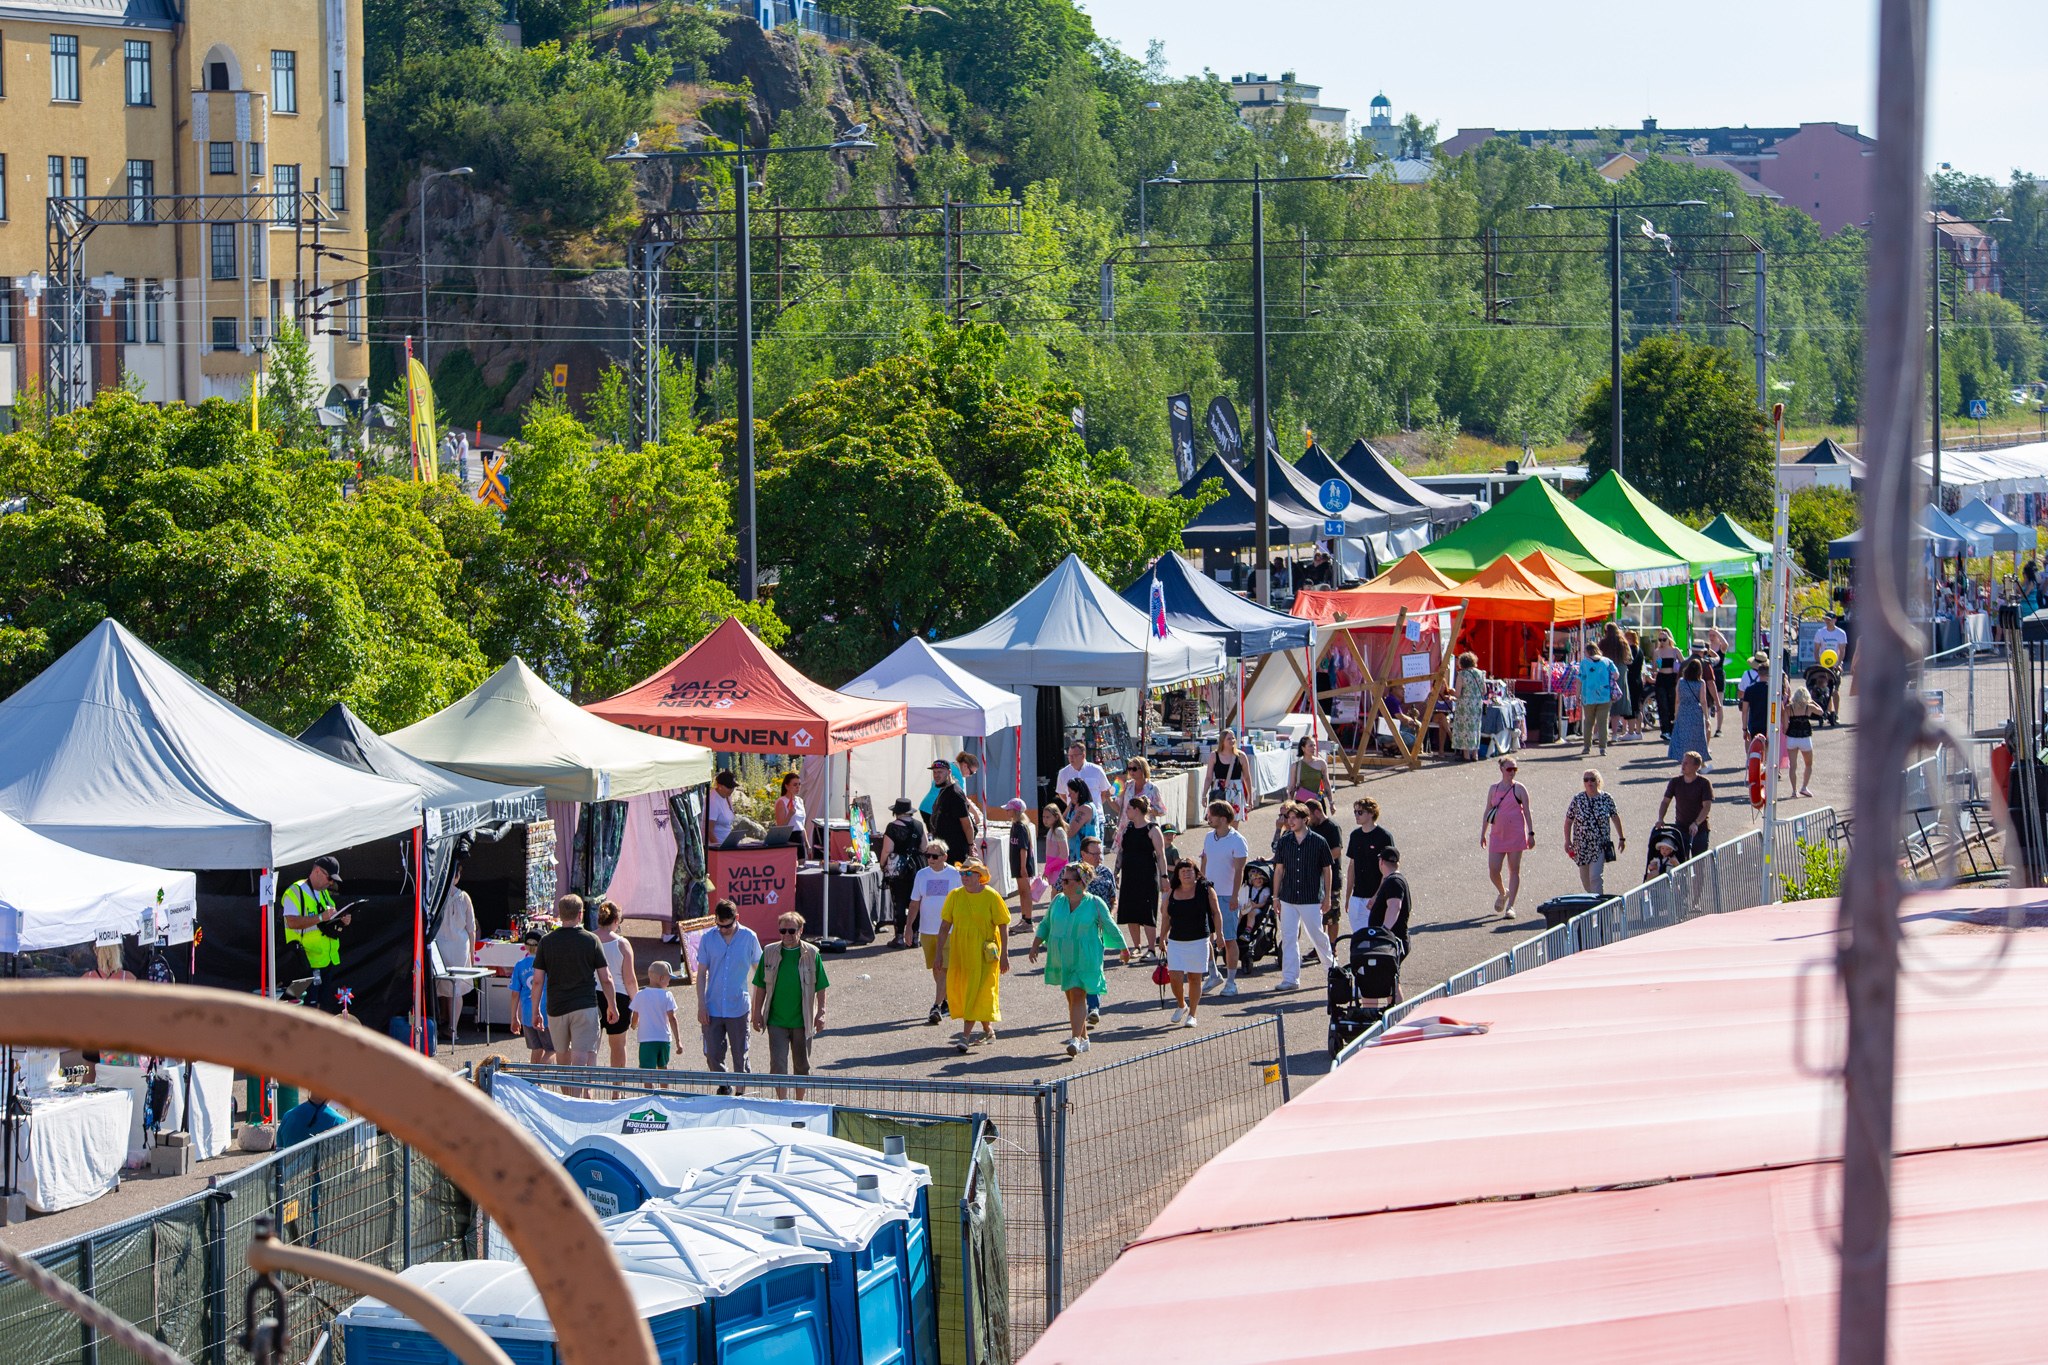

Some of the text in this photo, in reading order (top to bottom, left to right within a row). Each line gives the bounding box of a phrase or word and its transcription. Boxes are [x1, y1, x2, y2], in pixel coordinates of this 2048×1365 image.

[670, 680, 737, 691] VALO
[662, 690, 750, 700] KUITU
[657, 700, 713, 708] NEN
[494, 794, 537, 818] TATTOO
[447, 804, 479, 833] INKA
[728, 865, 775, 879] VALO
[728, 878, 785, 893] KUITU
[728, 893, 765, 906] NEN
[99, 930, 119, 941] KORUJA
